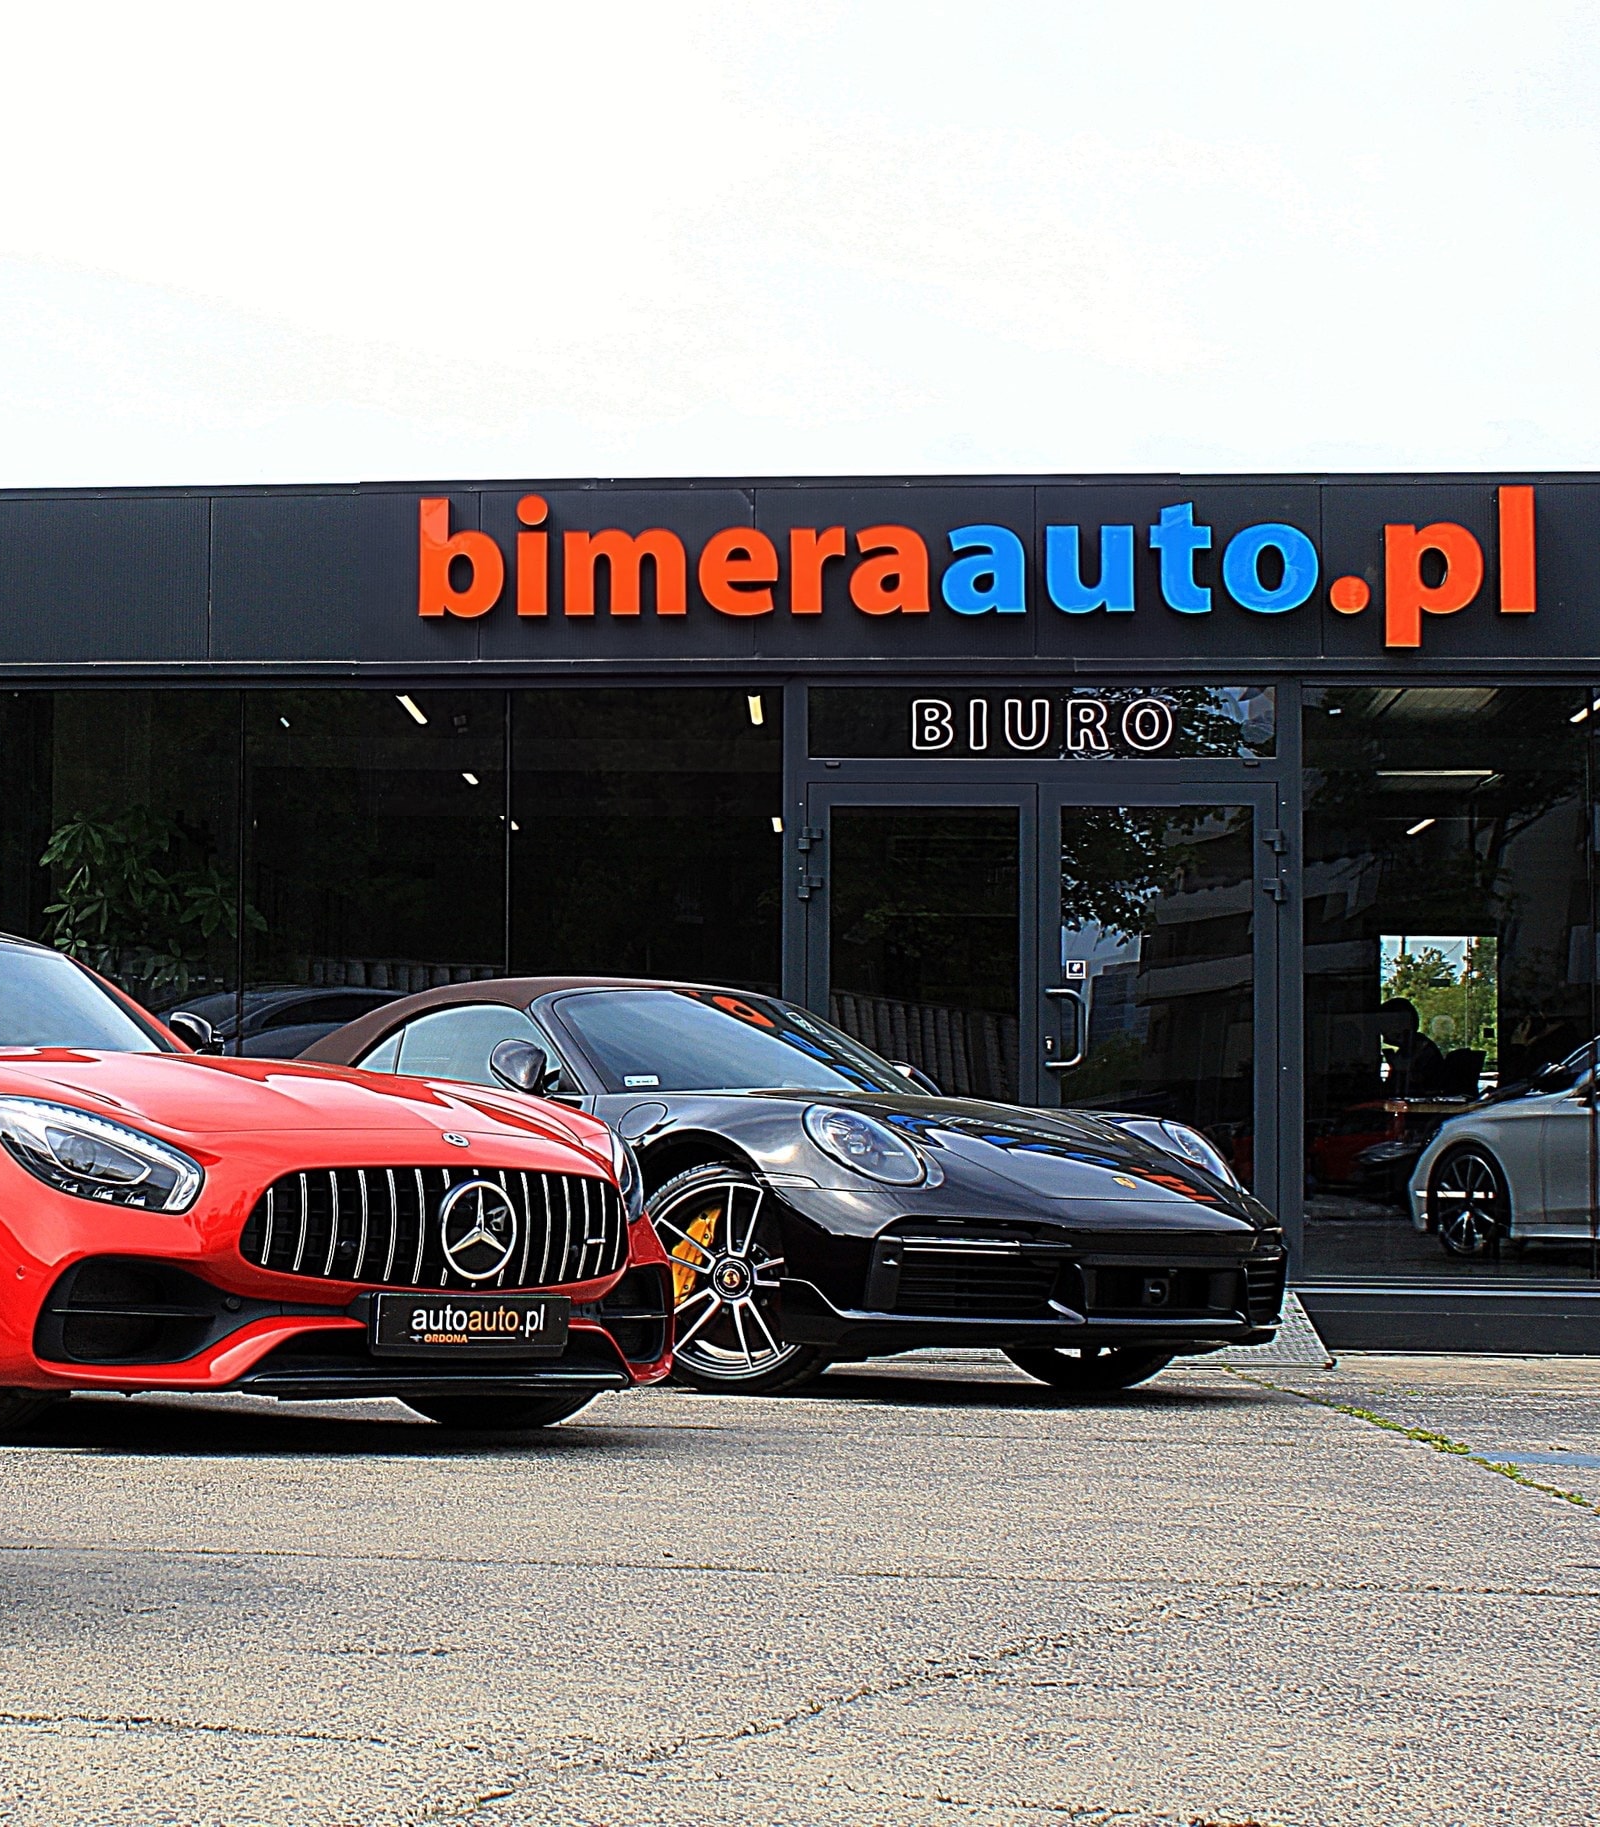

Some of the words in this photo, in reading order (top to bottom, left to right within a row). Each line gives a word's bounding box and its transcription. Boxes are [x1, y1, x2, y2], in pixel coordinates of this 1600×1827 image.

[417, 485, 1538, 649] bimeraauto.pl
[910, 696, 1175, 754] BIURO
[411, 1304, 545, 1338] autoauto.pl
[423, 1334, 468, 1343] ORDONA
